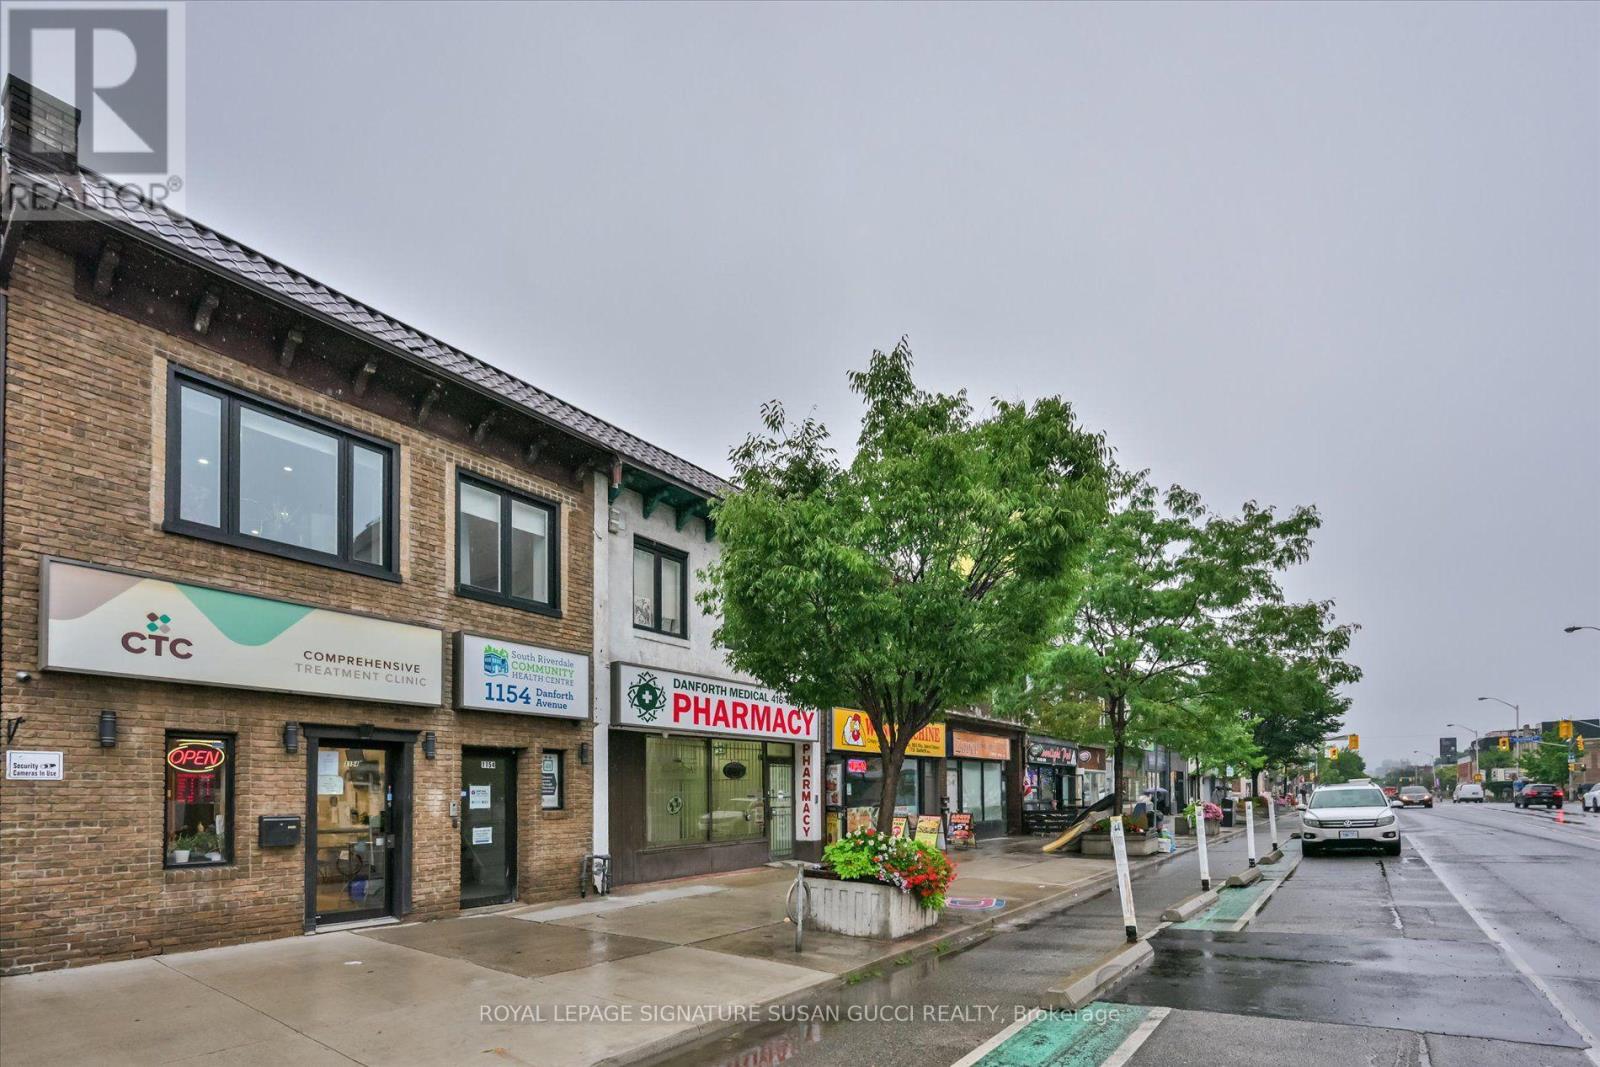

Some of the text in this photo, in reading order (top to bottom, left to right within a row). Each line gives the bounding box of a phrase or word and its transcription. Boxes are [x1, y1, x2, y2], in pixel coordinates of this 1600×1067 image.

[121, 631, 193, 660] CTC
[303, 650, 421, 674] COMPREHENSIVE
[511, 650, 575, 668] South Riverdale
[295, 662, 427, 687] TREATMENT CLINIC
[511, 661, 575, 678] COMMUNITY
[512, 671, 575, 687] HEALTH CENTRE
[485, 682, 574, 705] 1154 Danforth
[673, 678, 727, 696] DANFORTH
[729, 687, 769, 703] MEDICAL
[535, 698, 568, 710] Avenue
[673, 692, 815, 736] PHARMACY
[13, 762, 39, 770] Security
[170, 750, 220, 765] OPEN
[12, 769, 38, 777] Cameras
[801, 743, 811, 837] PHARMACY
